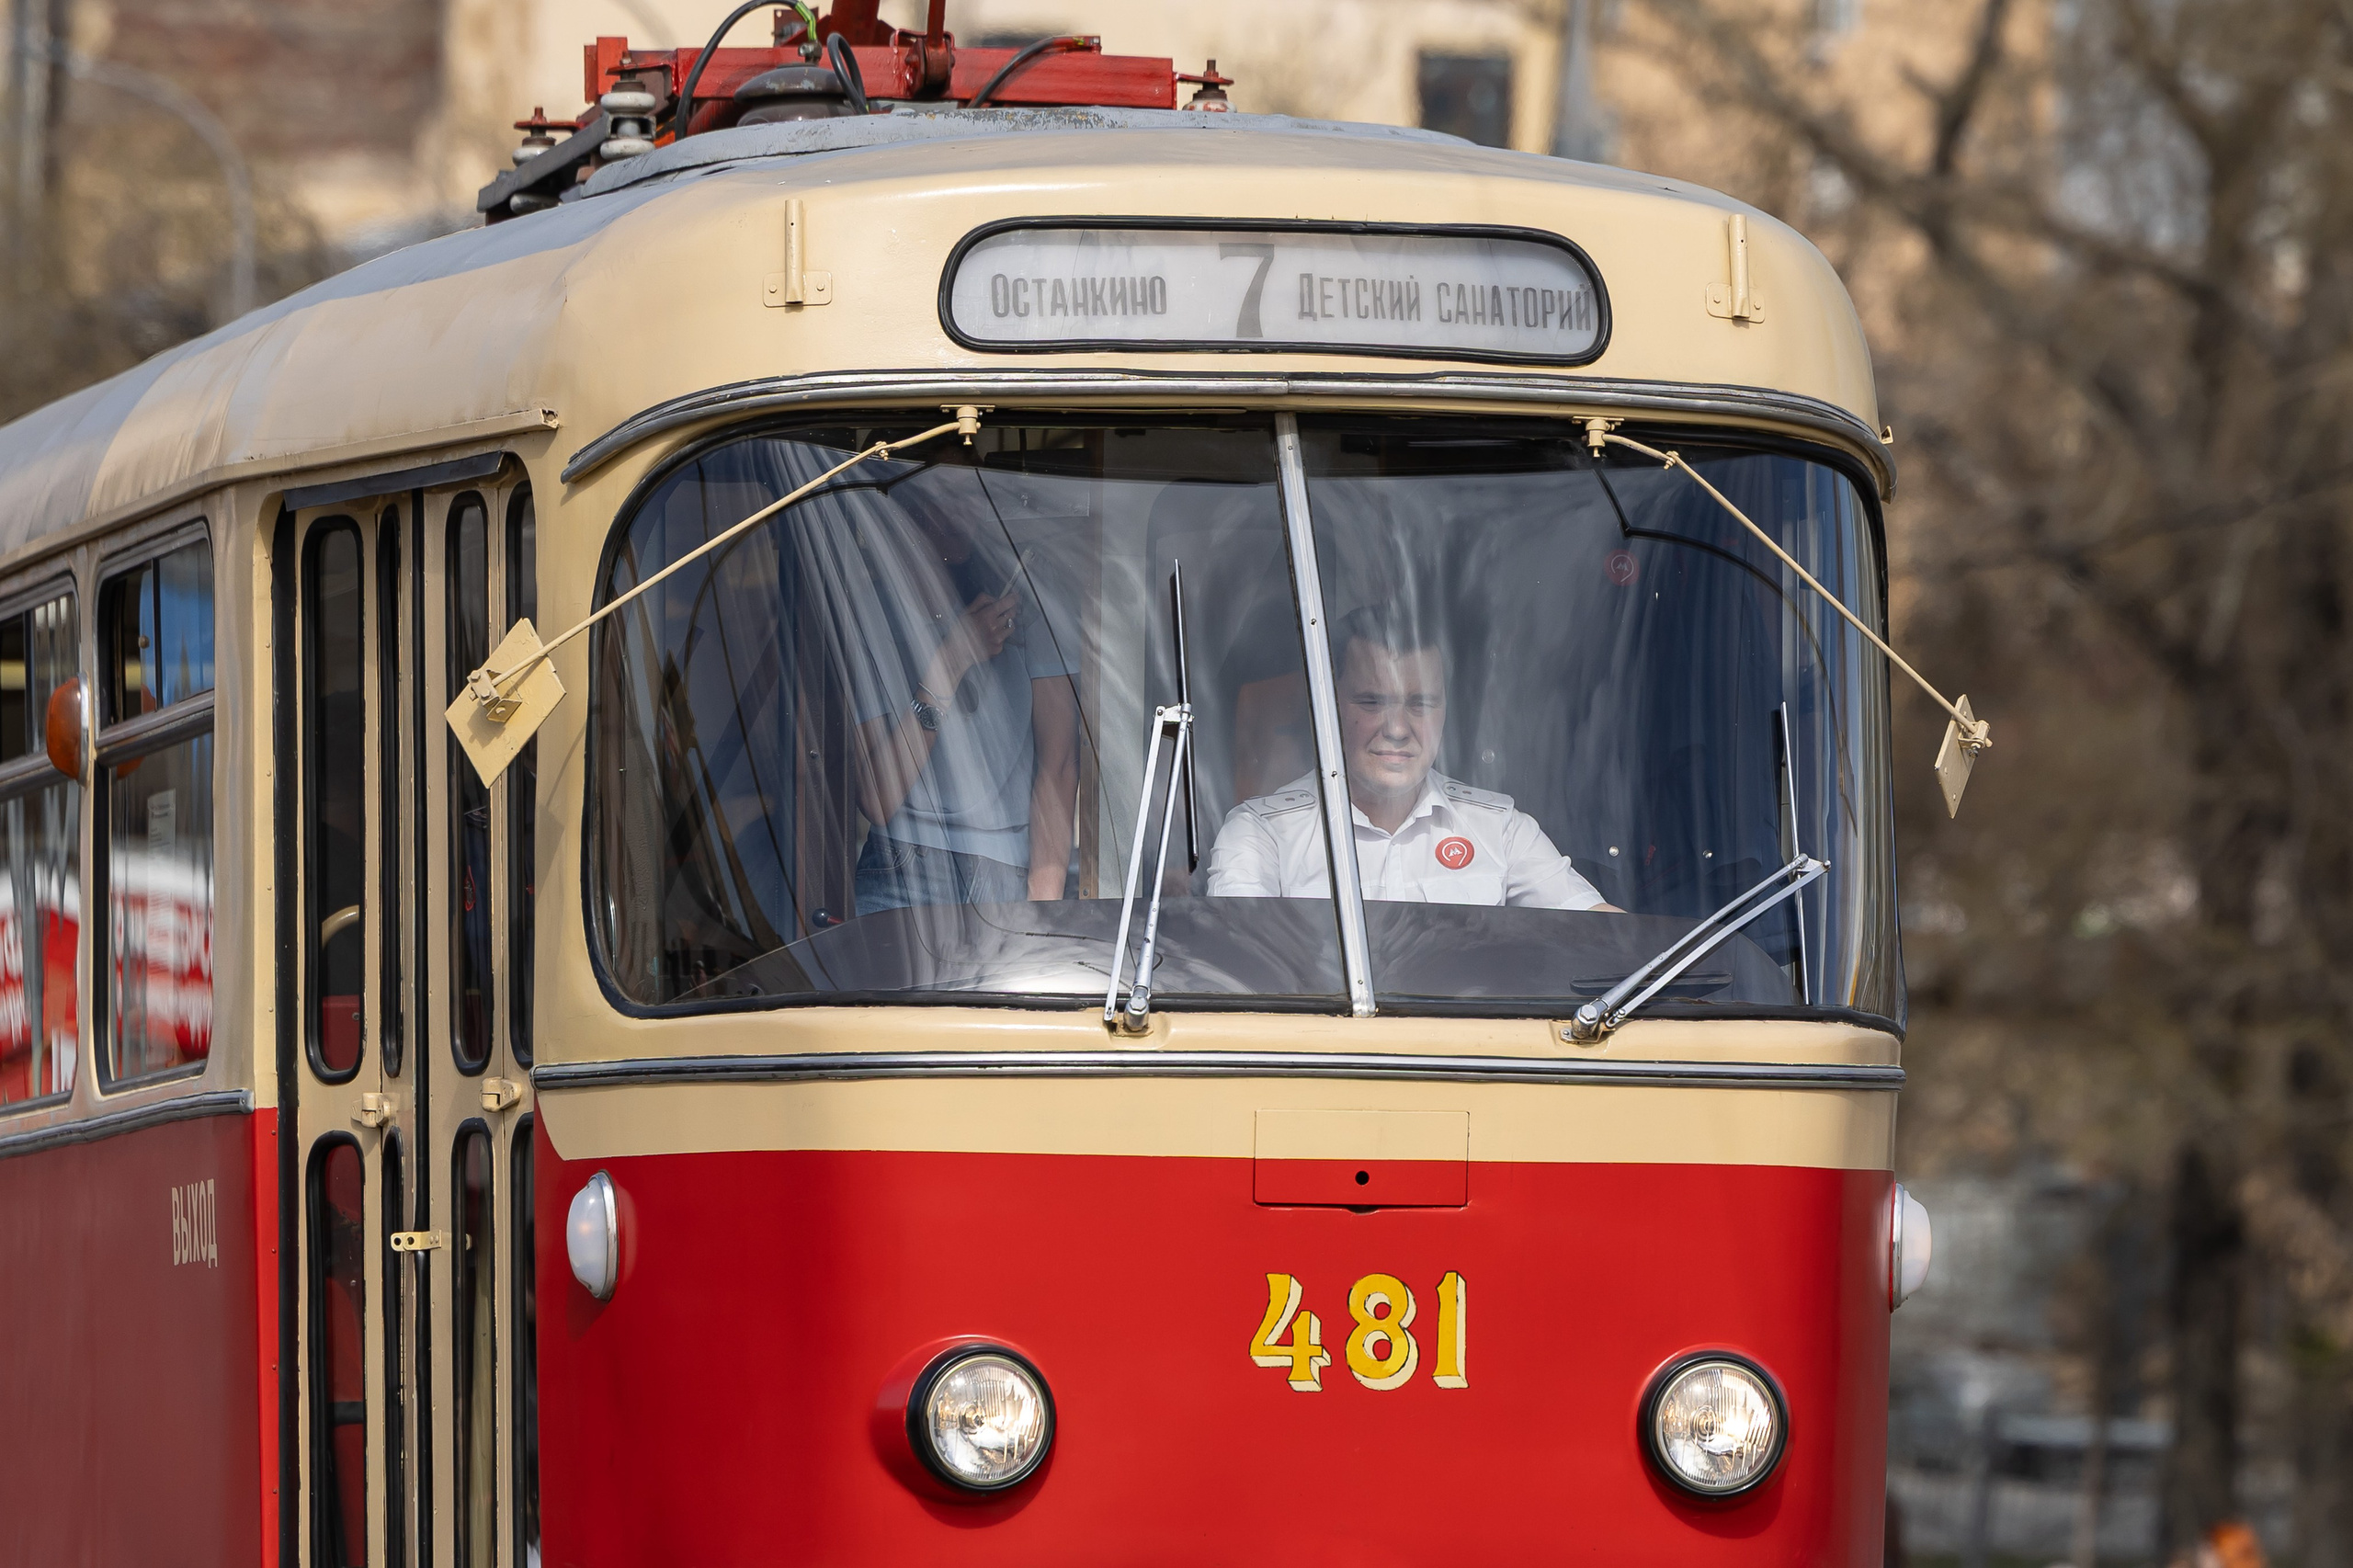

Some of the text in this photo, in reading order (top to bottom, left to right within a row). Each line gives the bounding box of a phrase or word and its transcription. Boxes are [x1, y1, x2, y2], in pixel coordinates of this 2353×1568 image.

[990, 243, 1592, 337] ОСТАНКИНО 7 ДЕТСКИЙ САНАТОРИЙ
[171, 1178, 218, 1268] ВЫХОД
[1249, 1270, 1470, 1392] 481
